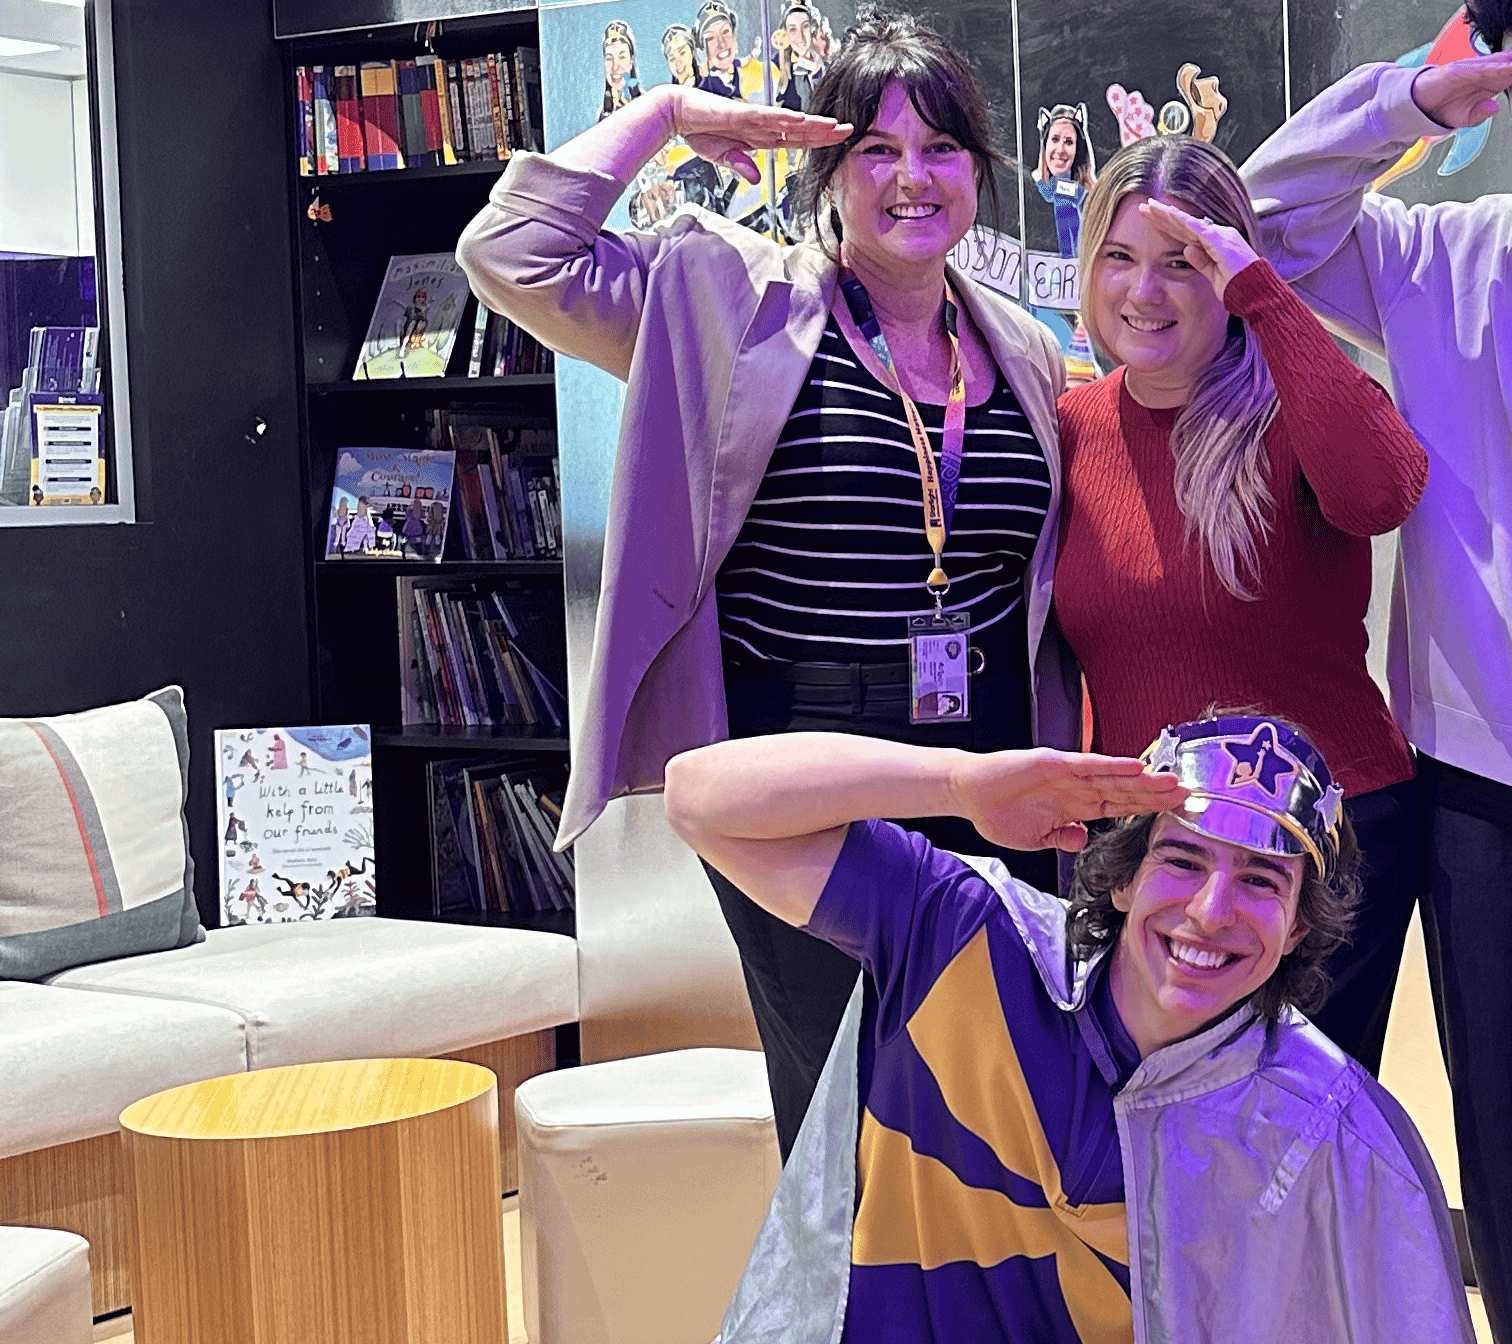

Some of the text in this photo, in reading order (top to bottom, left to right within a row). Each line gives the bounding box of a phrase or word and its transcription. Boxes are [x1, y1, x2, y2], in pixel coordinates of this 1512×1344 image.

[1033, 261, 1080, 300] EAR
[298, 787, 307, 796] a
[301, 800, 334, 823] from
